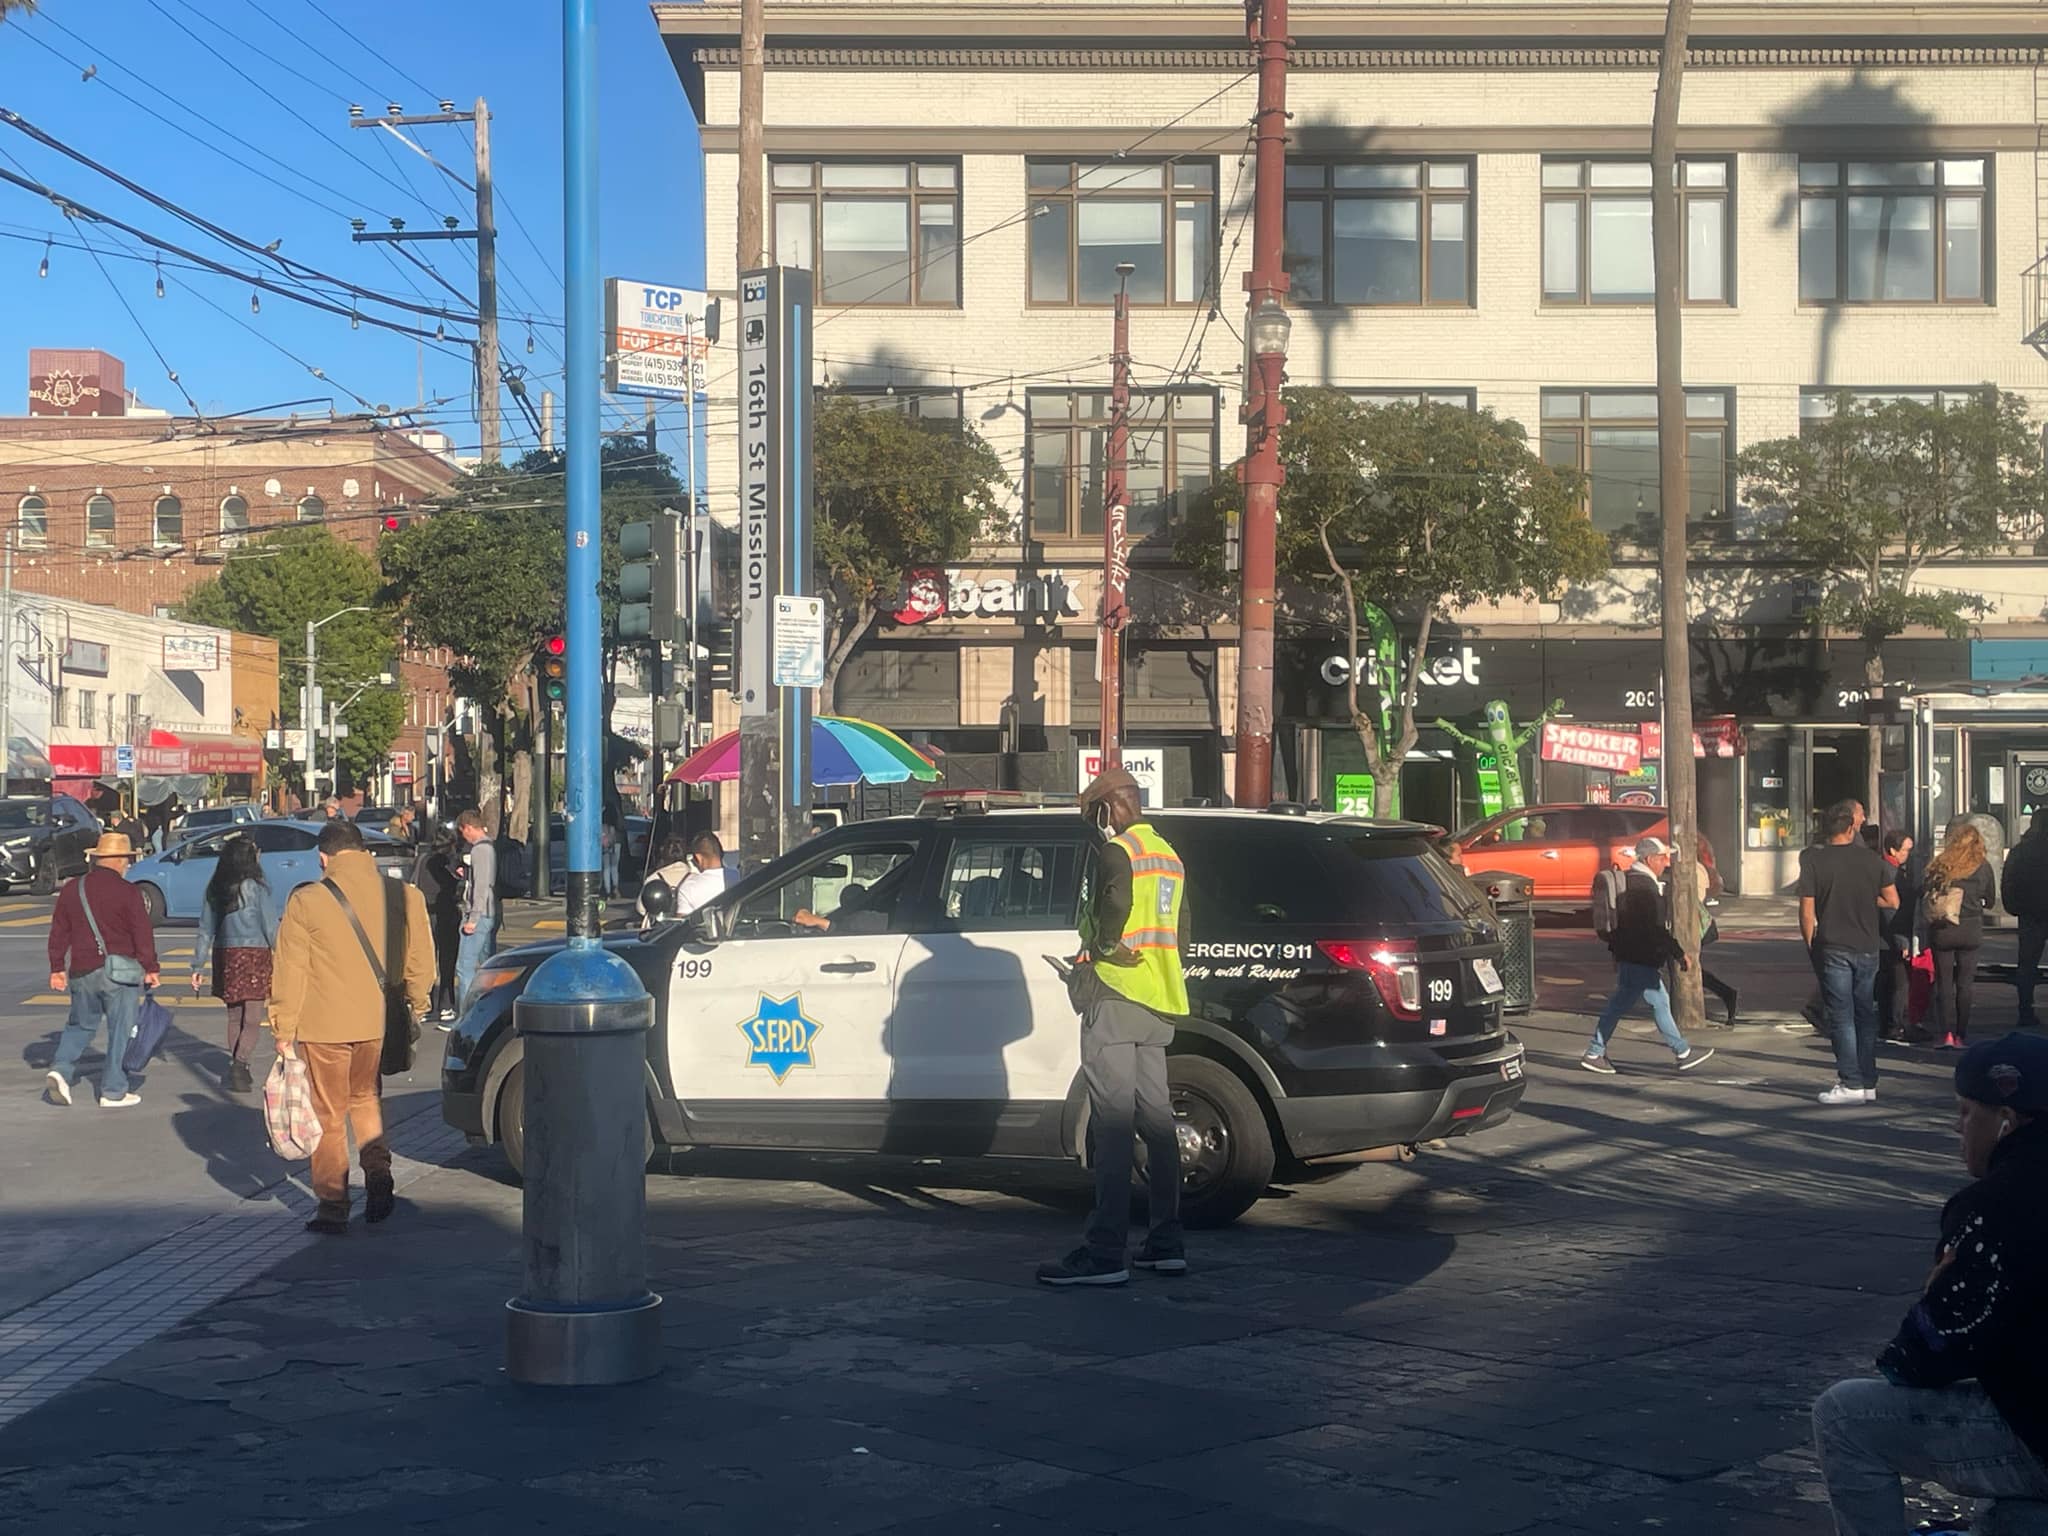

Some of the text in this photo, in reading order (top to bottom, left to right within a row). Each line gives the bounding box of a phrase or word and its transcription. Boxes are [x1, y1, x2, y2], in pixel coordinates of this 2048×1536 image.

[643, 288, 682, 310] TCP
[621, 331, 704, 357] FOR LEAE
[749, 363, 767, 600] 16th St Mission
[944, 568, 1084, 613] bank
[1320, 648, 1481, 686] criket
[1546, 723, 1639, 755] SMOKER
[1122, 757, 1155, 772] ank
[1480, 756, 1497, 769] OP
[1552, 743, 1627, 771] FRIENDLY
[1283, 944, 1312, 959] 911
[677, 959, 712, 978] 199
[1214, 964, 1247, 978] with
[1248, 963, 1301, 981] Respect
[1428, 980, 1453, 1002] 199
